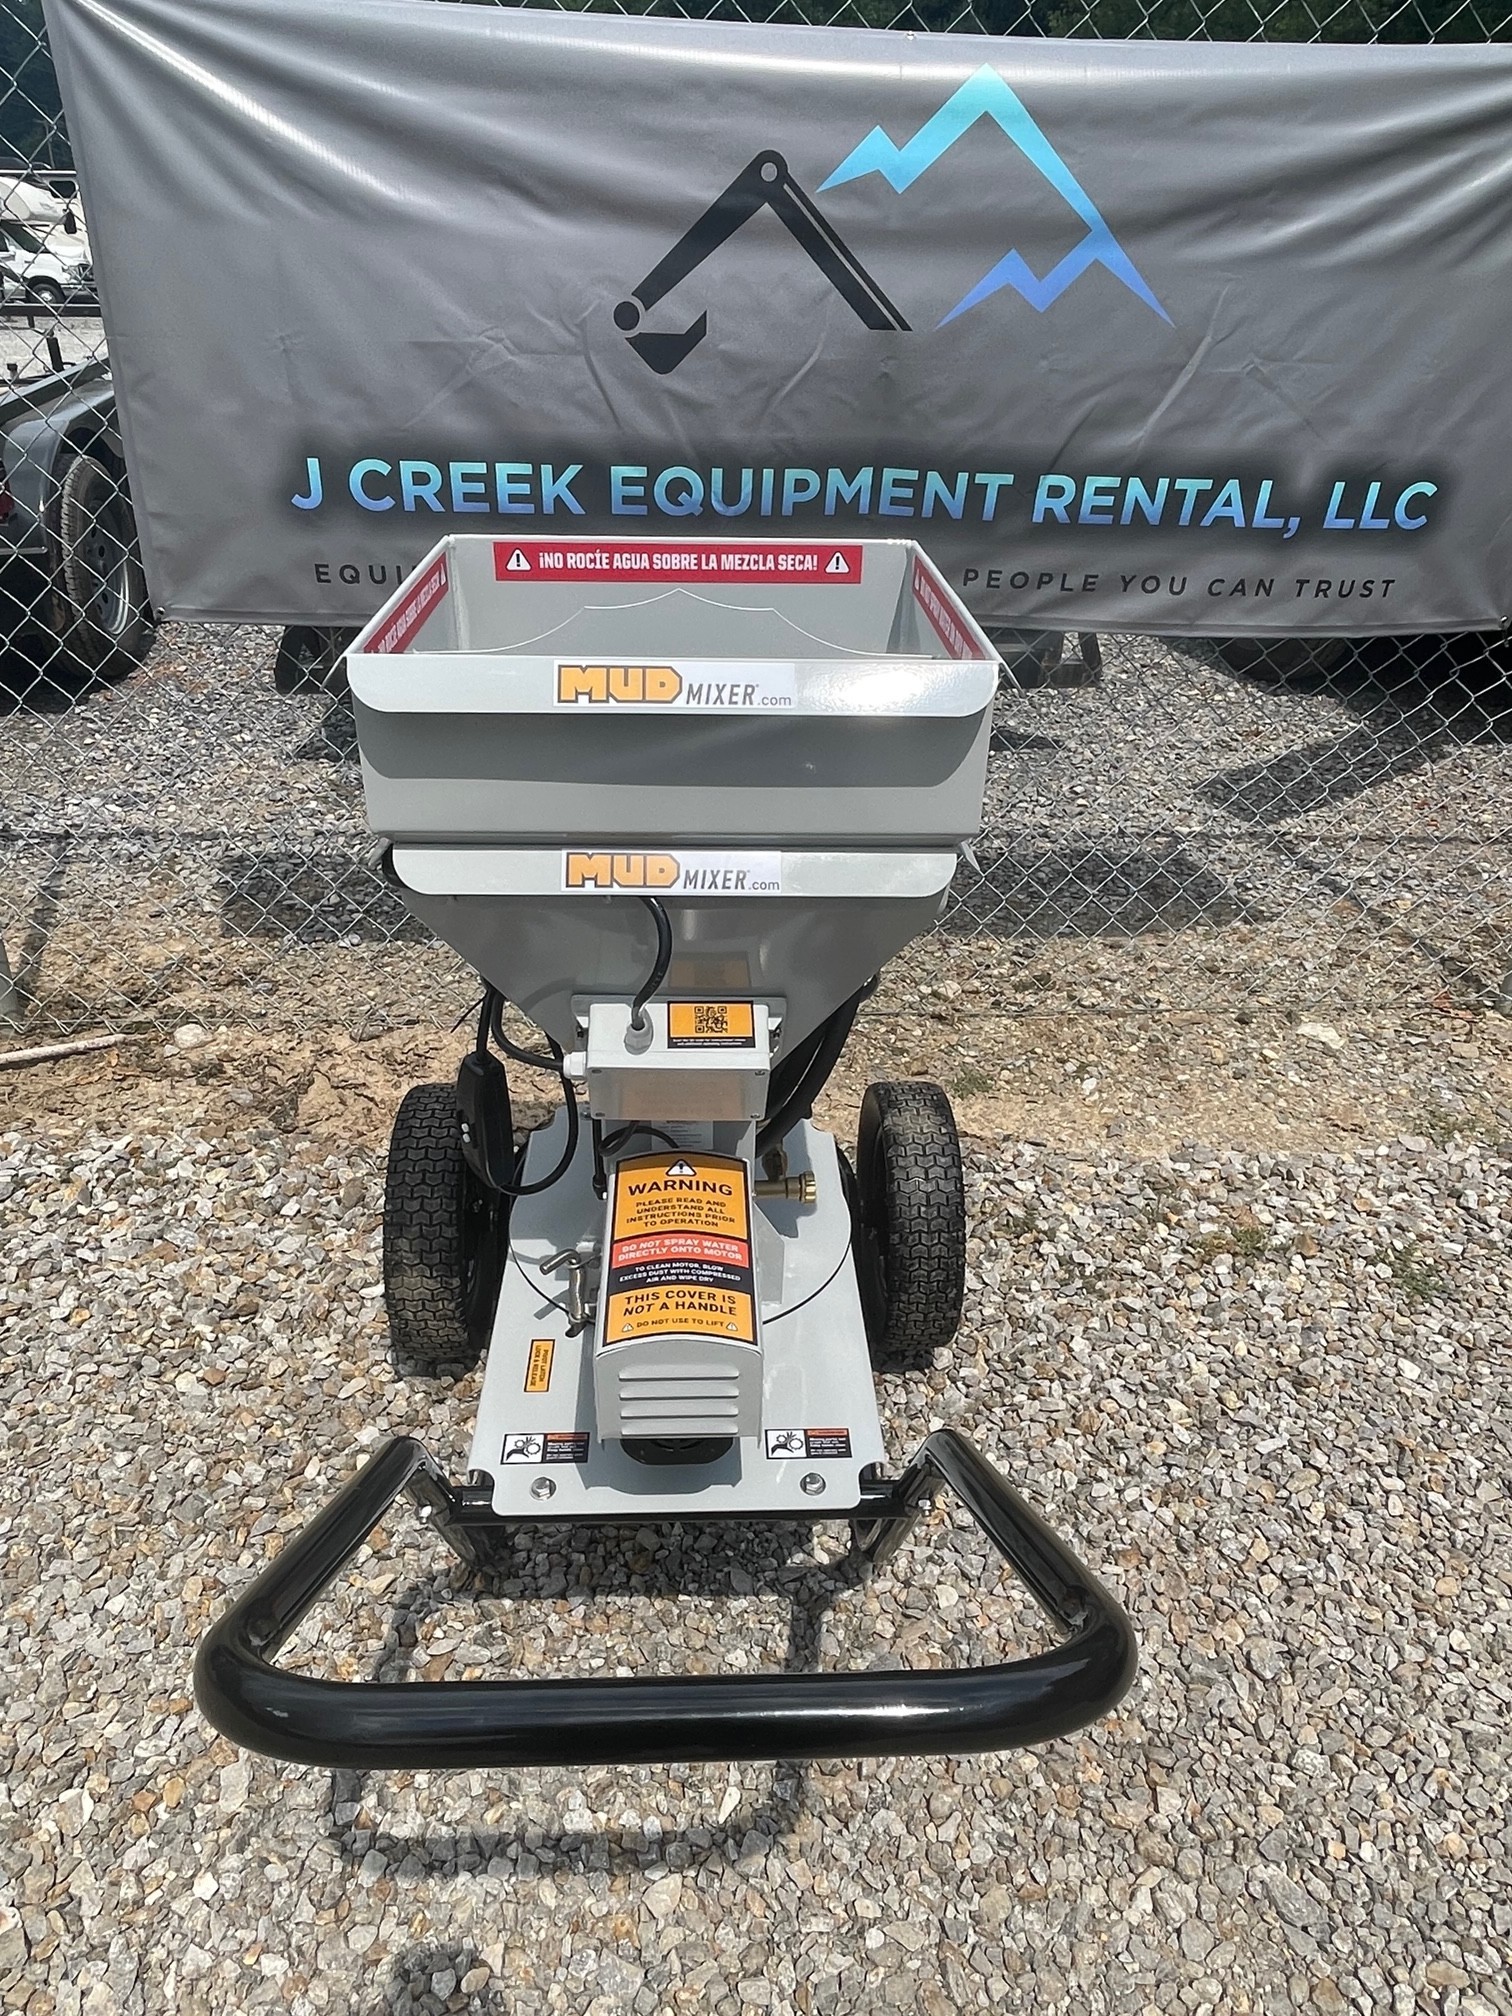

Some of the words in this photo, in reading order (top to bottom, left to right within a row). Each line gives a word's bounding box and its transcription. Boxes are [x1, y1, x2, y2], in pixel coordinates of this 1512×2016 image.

[291, 457, 323, 510] J
[348, 458, 586, 515] CREEK
[610, 465, 1014, 522] EQUIPMENT
[1032, 474, 1301, 539] RENTAL,
[1322, 480, 1438, 530] LLC
[539, 552, 564, 570] ¡NO
[567, 548, 610, 570] ROCÍE
[612, 552, 650, 570] AGUA
[652, 553, 699, 570] SOBRE
[700, 554, 718, 571] LA
[720, 554, 775, 571] MEZCLA
[778, 554, 818, 571] SECA!
[314, 564, 416, 584] EQUI
[962, 568, 1099, 593] PEOPLE
[1120, 574, 1188, 596] YOU
[1207, 578, 1276, 598] CAN
[1295, 578, 1396, 599] TRUST
[558, 664, 682, 704] MUD
[566, 852, 680, 888] MUD
[628, 1180, 732, 1196] WARNING
[636, 1198, 674, 1208] PLEASE
[706, 1199, 726, 1208] AND
[636, 1204, 704, 1214] UNDERSTAND
[626, 1211, 702, 1224] INSTRUCTIONS
[705, 1213, 735, 1223] PRIOR
[660, 1218, 718, 1227] OPERATION
[622, 1244, 637, 1253] DO
[640, 1240, 662, 1249] NOT
[702, 1240, 738, 1252] WATER
[618, 1247, 668, 1262] DIRECTLY
[704, 1248, 743, 1260] MOTOR
[619, 1272, 647, 1282] EXCESS
[691, 1269, 741, 1281] COMPRESSED
[625, 1292, 660, 1304] THIS
[665, 1290, 716, 1301] COVER
[722, 1294, 736, 1304] IS
[623, 1303, 655, 1316] NOT
[659, 1302, 669, 1311] A
[675, 1301, 737, 1316] HANDLE
